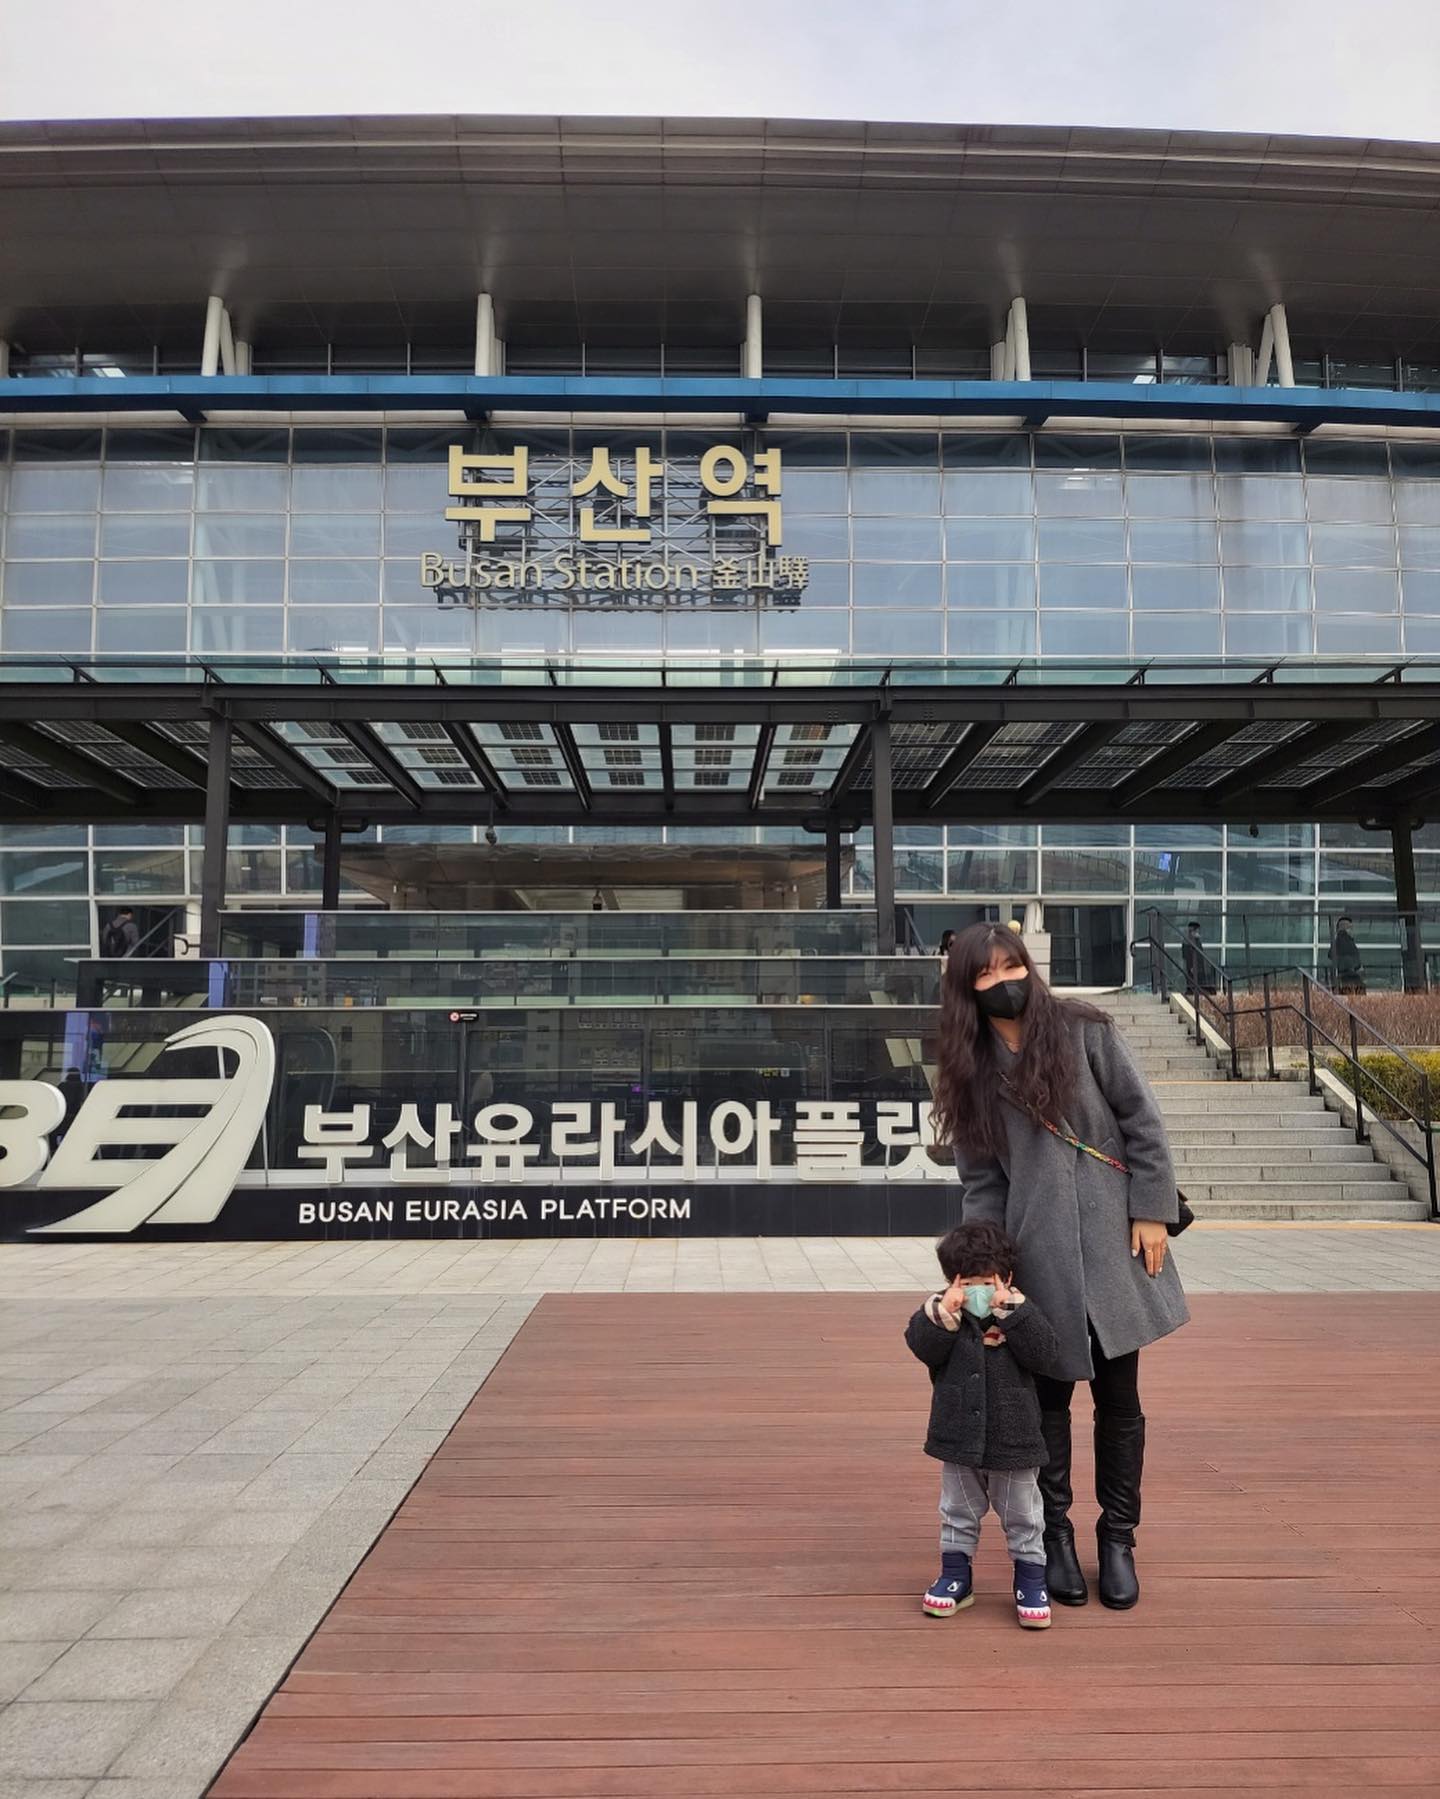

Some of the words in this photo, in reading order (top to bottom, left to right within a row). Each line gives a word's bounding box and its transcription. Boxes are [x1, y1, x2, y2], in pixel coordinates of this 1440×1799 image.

[445, 445, 782, 547] 부산역
[420, 552, 543, 588] Busan
[553, 553, 698, 590] Station
[299, 1202, 393, 1224] BUSAN
[405, 1200, 528, 1222] EURASIA
[540, 1198, 691, 1220] PLATFORM
